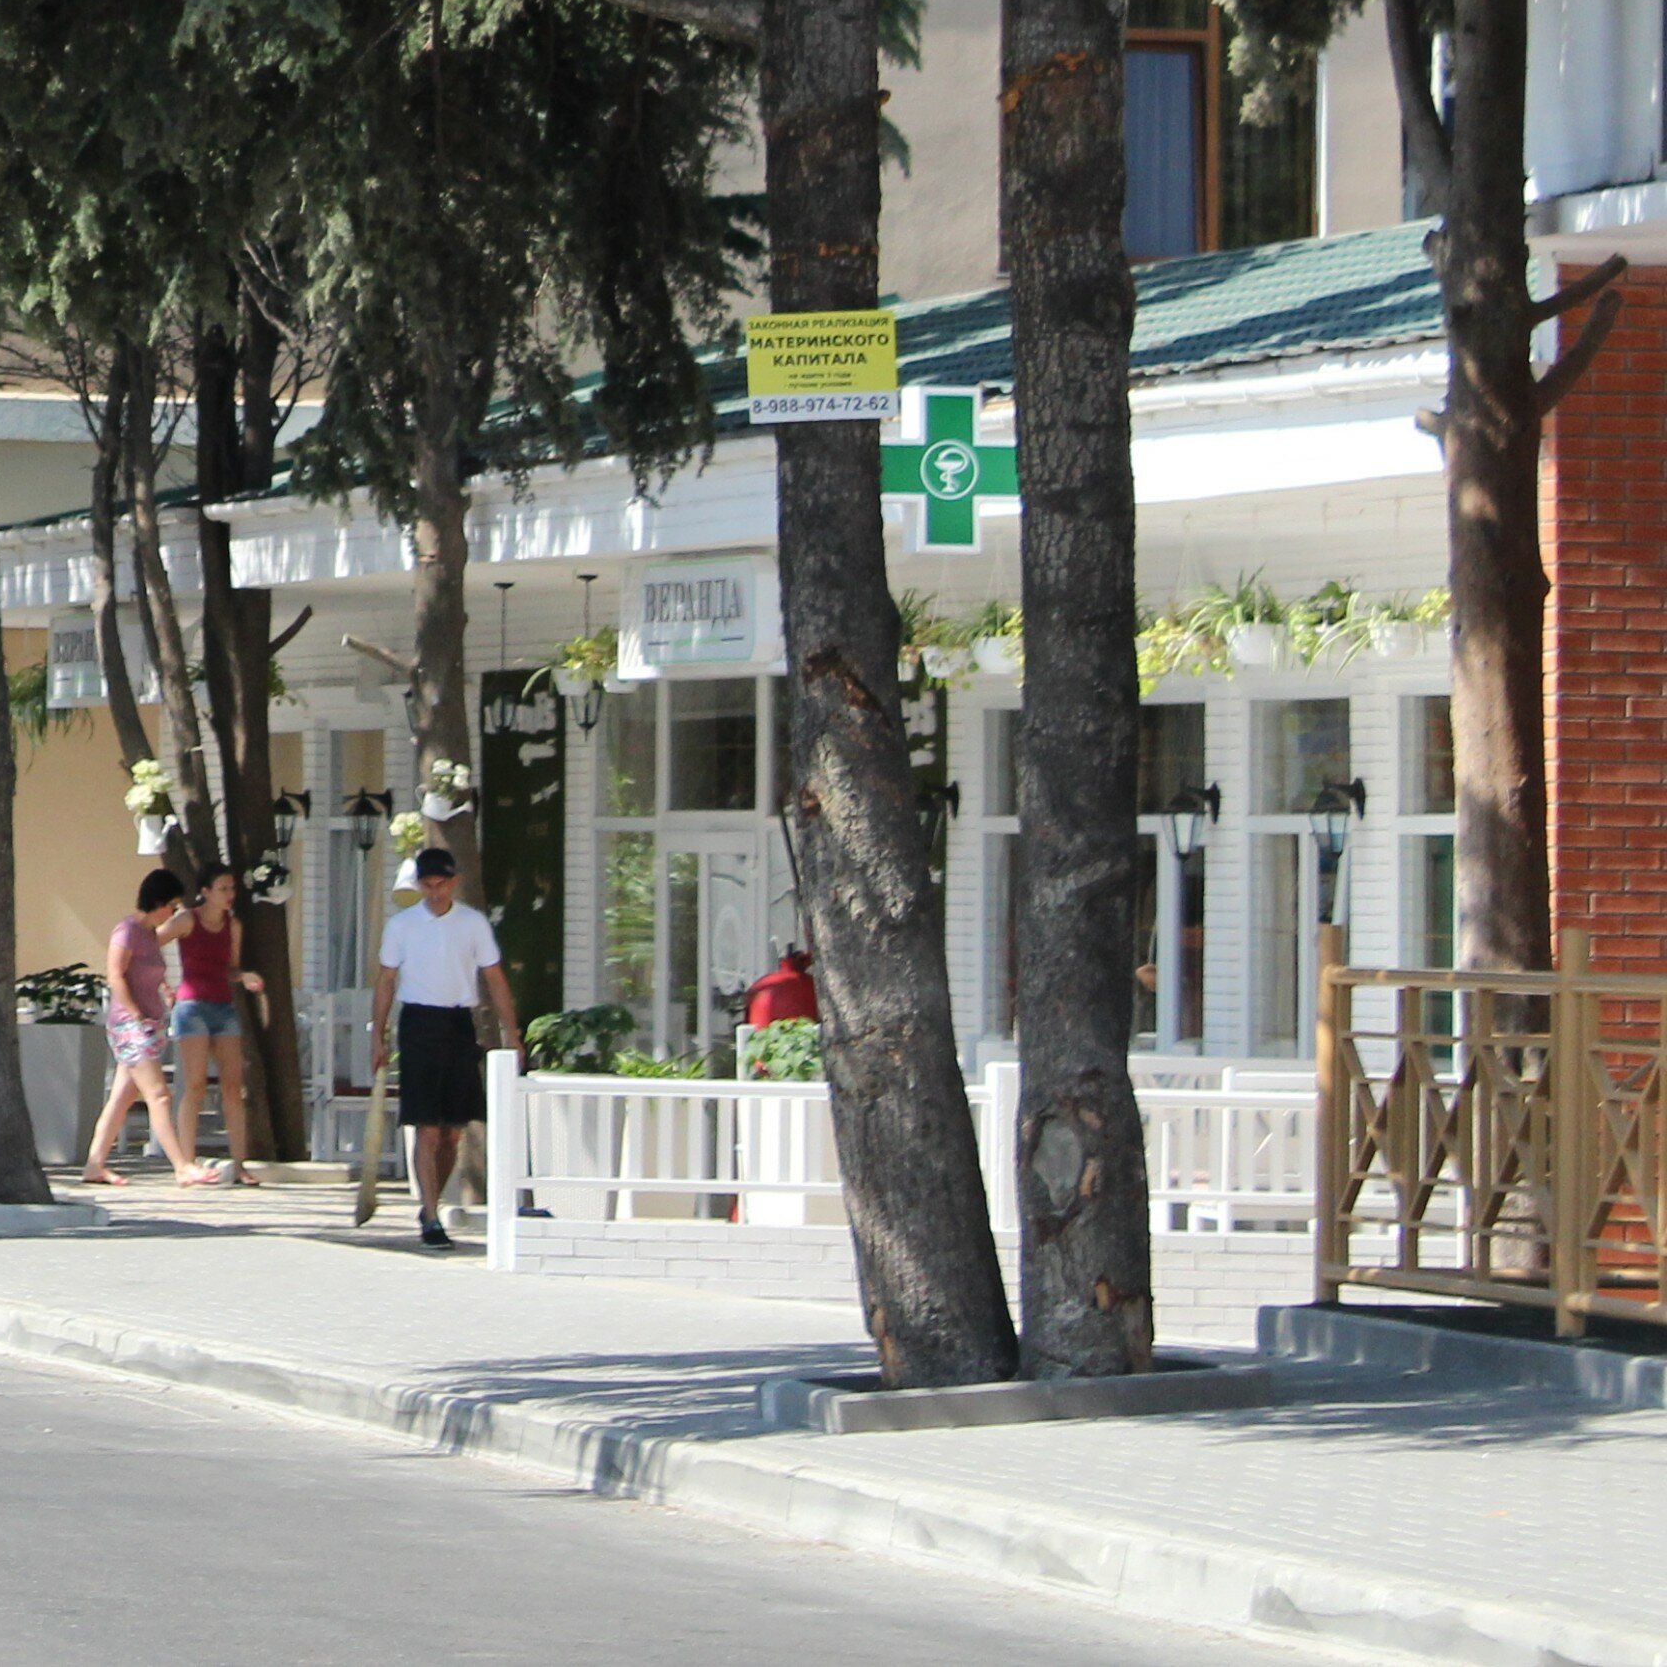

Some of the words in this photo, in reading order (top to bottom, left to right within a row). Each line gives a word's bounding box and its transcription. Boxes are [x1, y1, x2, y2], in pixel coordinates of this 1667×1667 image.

[749, 320, 809, 330] ЗАКОННАЯ
[812, 317, 889, 328] РЕАЛИЗАЦИЯ
[749, 334, 889, 349] МАТЕРИНСКОГО
[773, 352, 867, 367] КАПИТАЛА
[752, 395, 889, 414] 8-988-974-72-62
[644, 578, 741, 631] ВЕРАНДА
